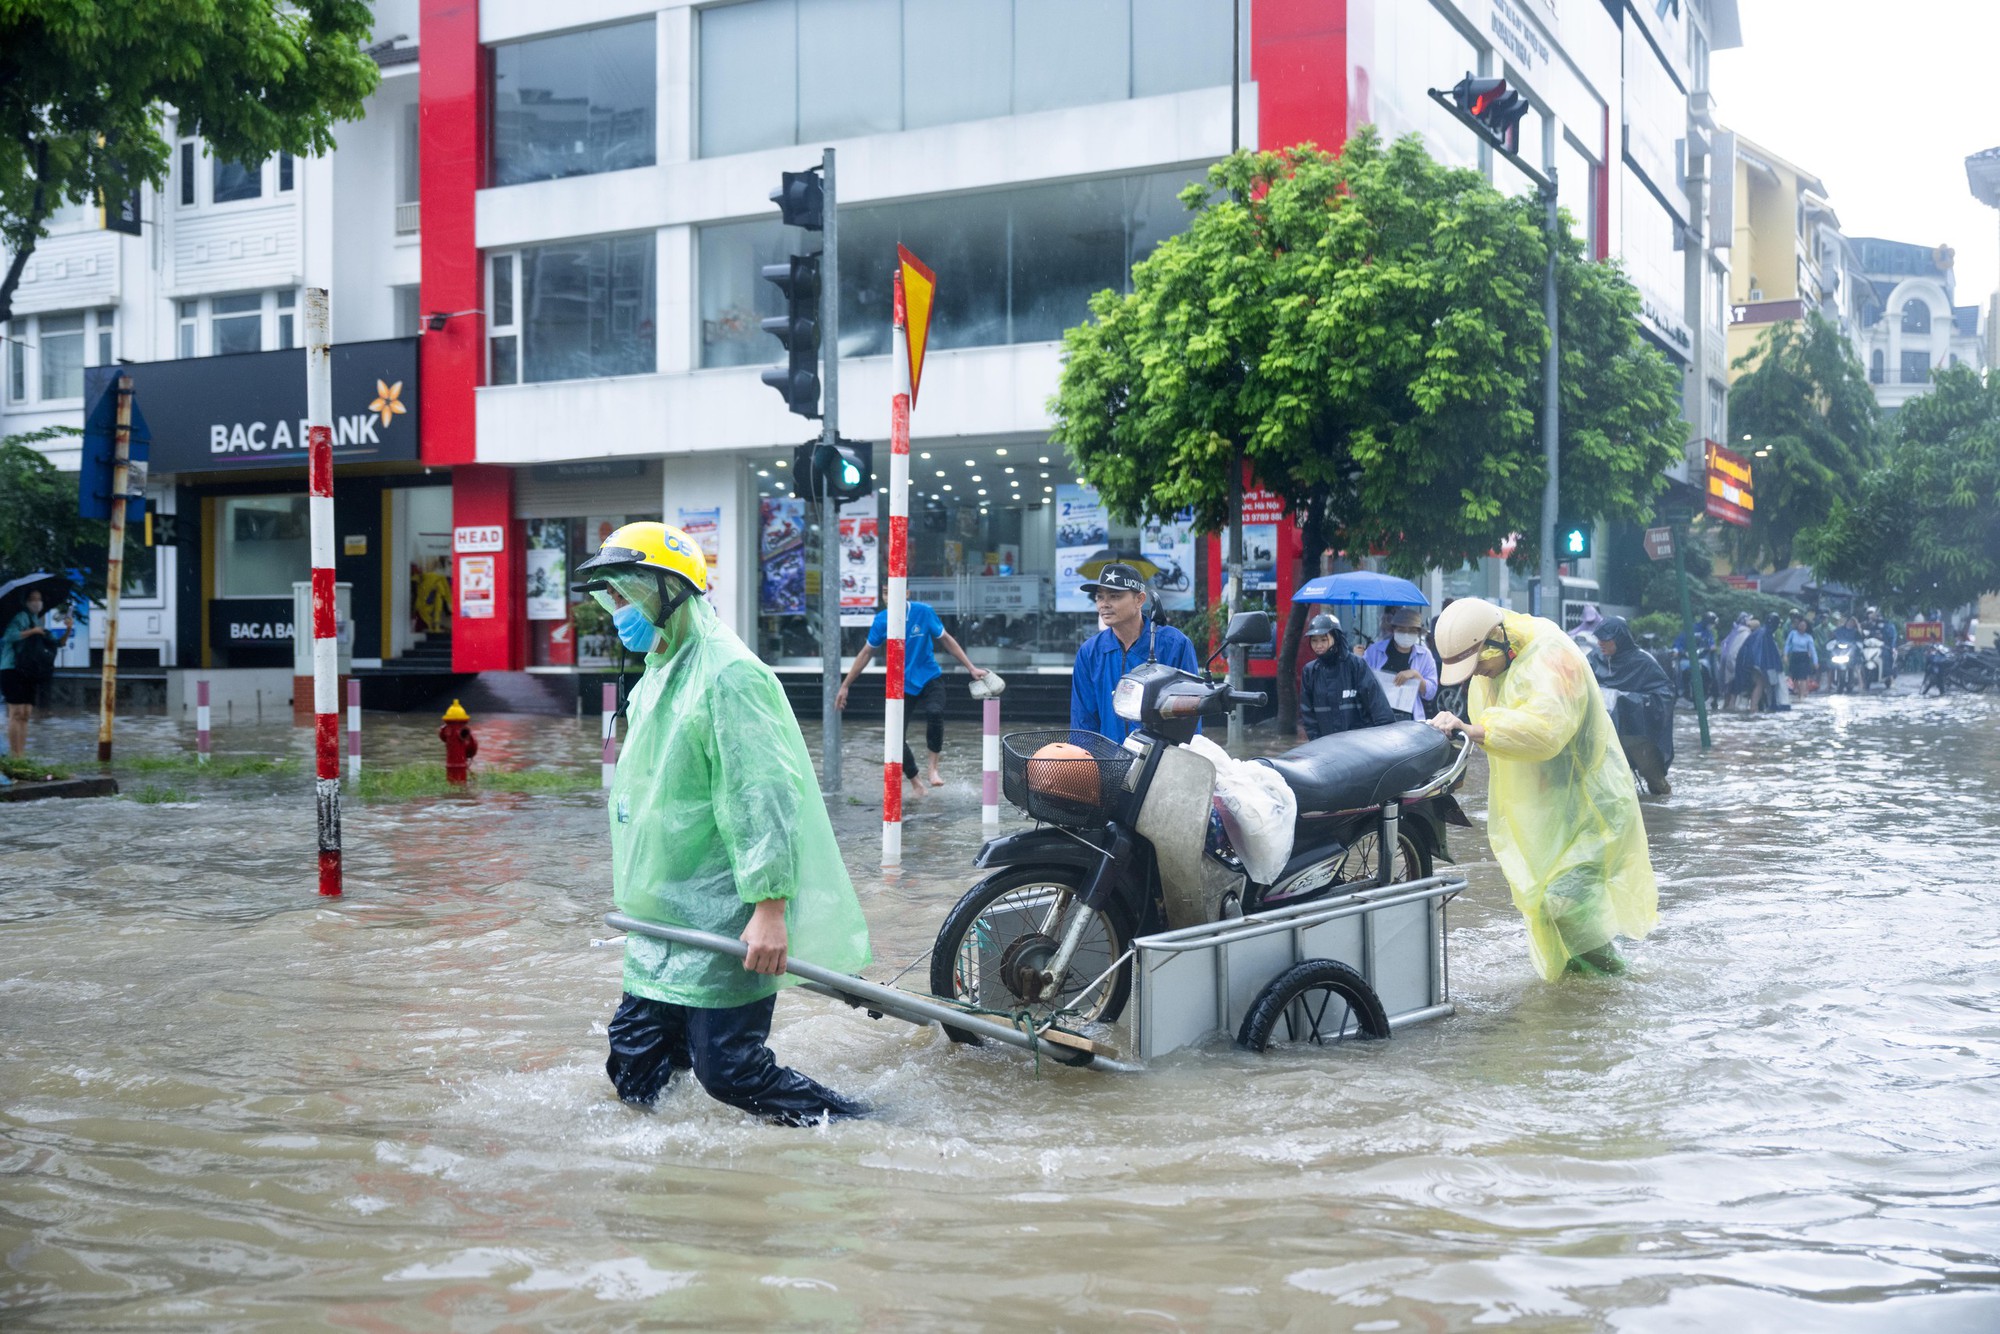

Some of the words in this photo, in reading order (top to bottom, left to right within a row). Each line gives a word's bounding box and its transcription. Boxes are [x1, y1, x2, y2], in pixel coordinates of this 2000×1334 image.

[211, 421, 267, 454] BAC
[271, 419, 294, 450] A
[1062, 503, 1071, 516] 2
[458, 530, 499, 544] HEAD
[664, 529, 693, 558] be
[1123, 578, 1140, 590] LUCKY
[230, 622, 261, 639] BAC
[261, 622, 274, 639] A
[275, 622, 295, 639] BA
